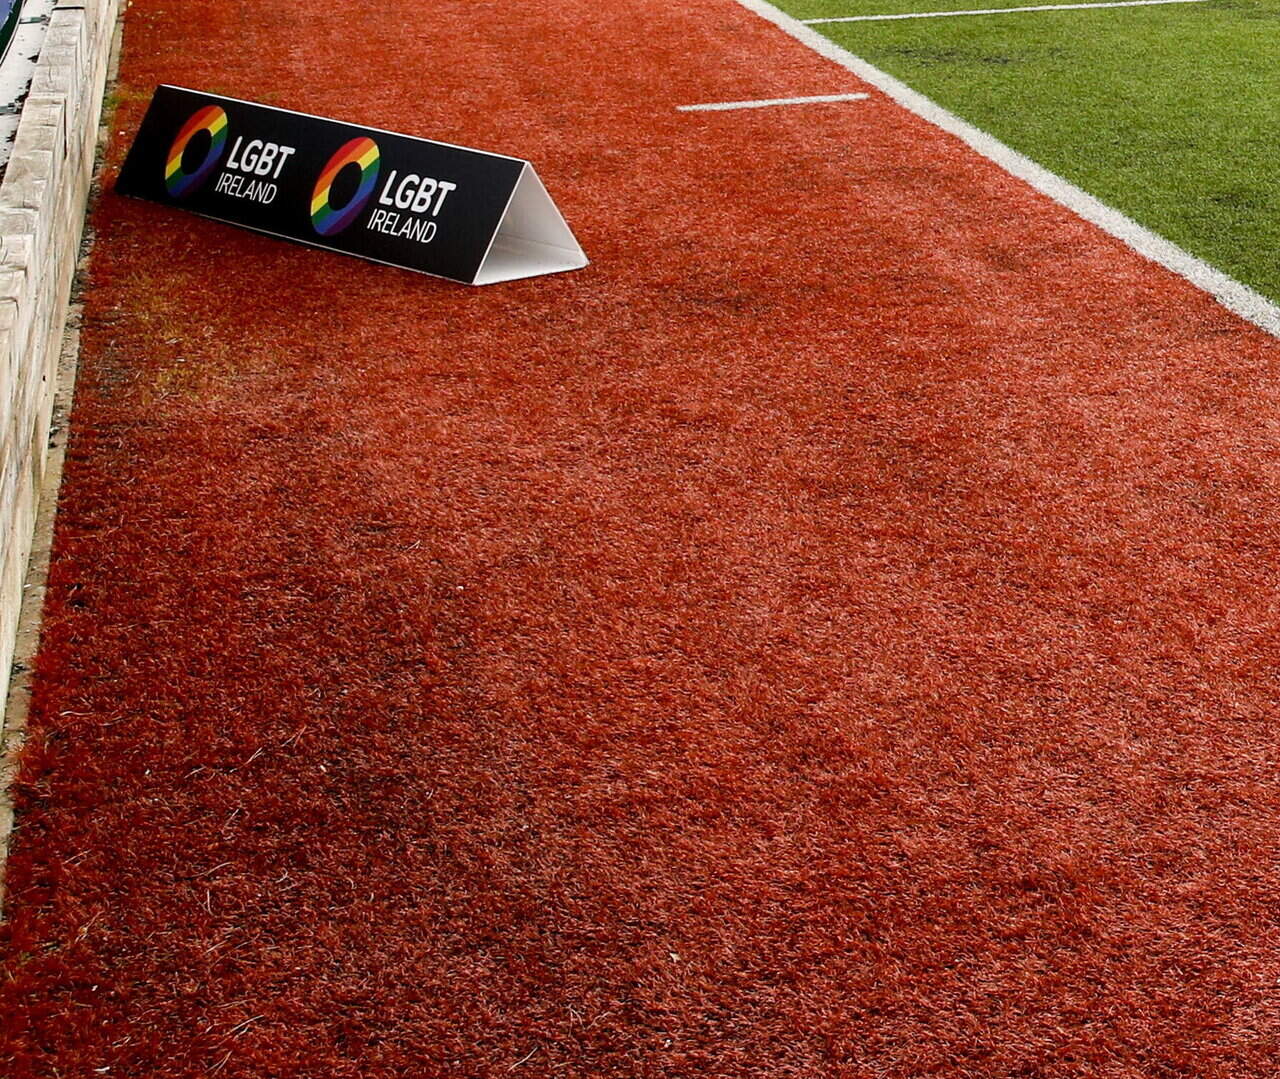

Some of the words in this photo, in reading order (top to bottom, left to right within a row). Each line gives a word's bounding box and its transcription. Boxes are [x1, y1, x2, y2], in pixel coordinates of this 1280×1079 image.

[225, 135, 295, 179] LGBT
[214, 171, 278, 205] IRELAND
[378, 169, 457, 217] LGBT
[366, 208, 438, 244] IRELAND
